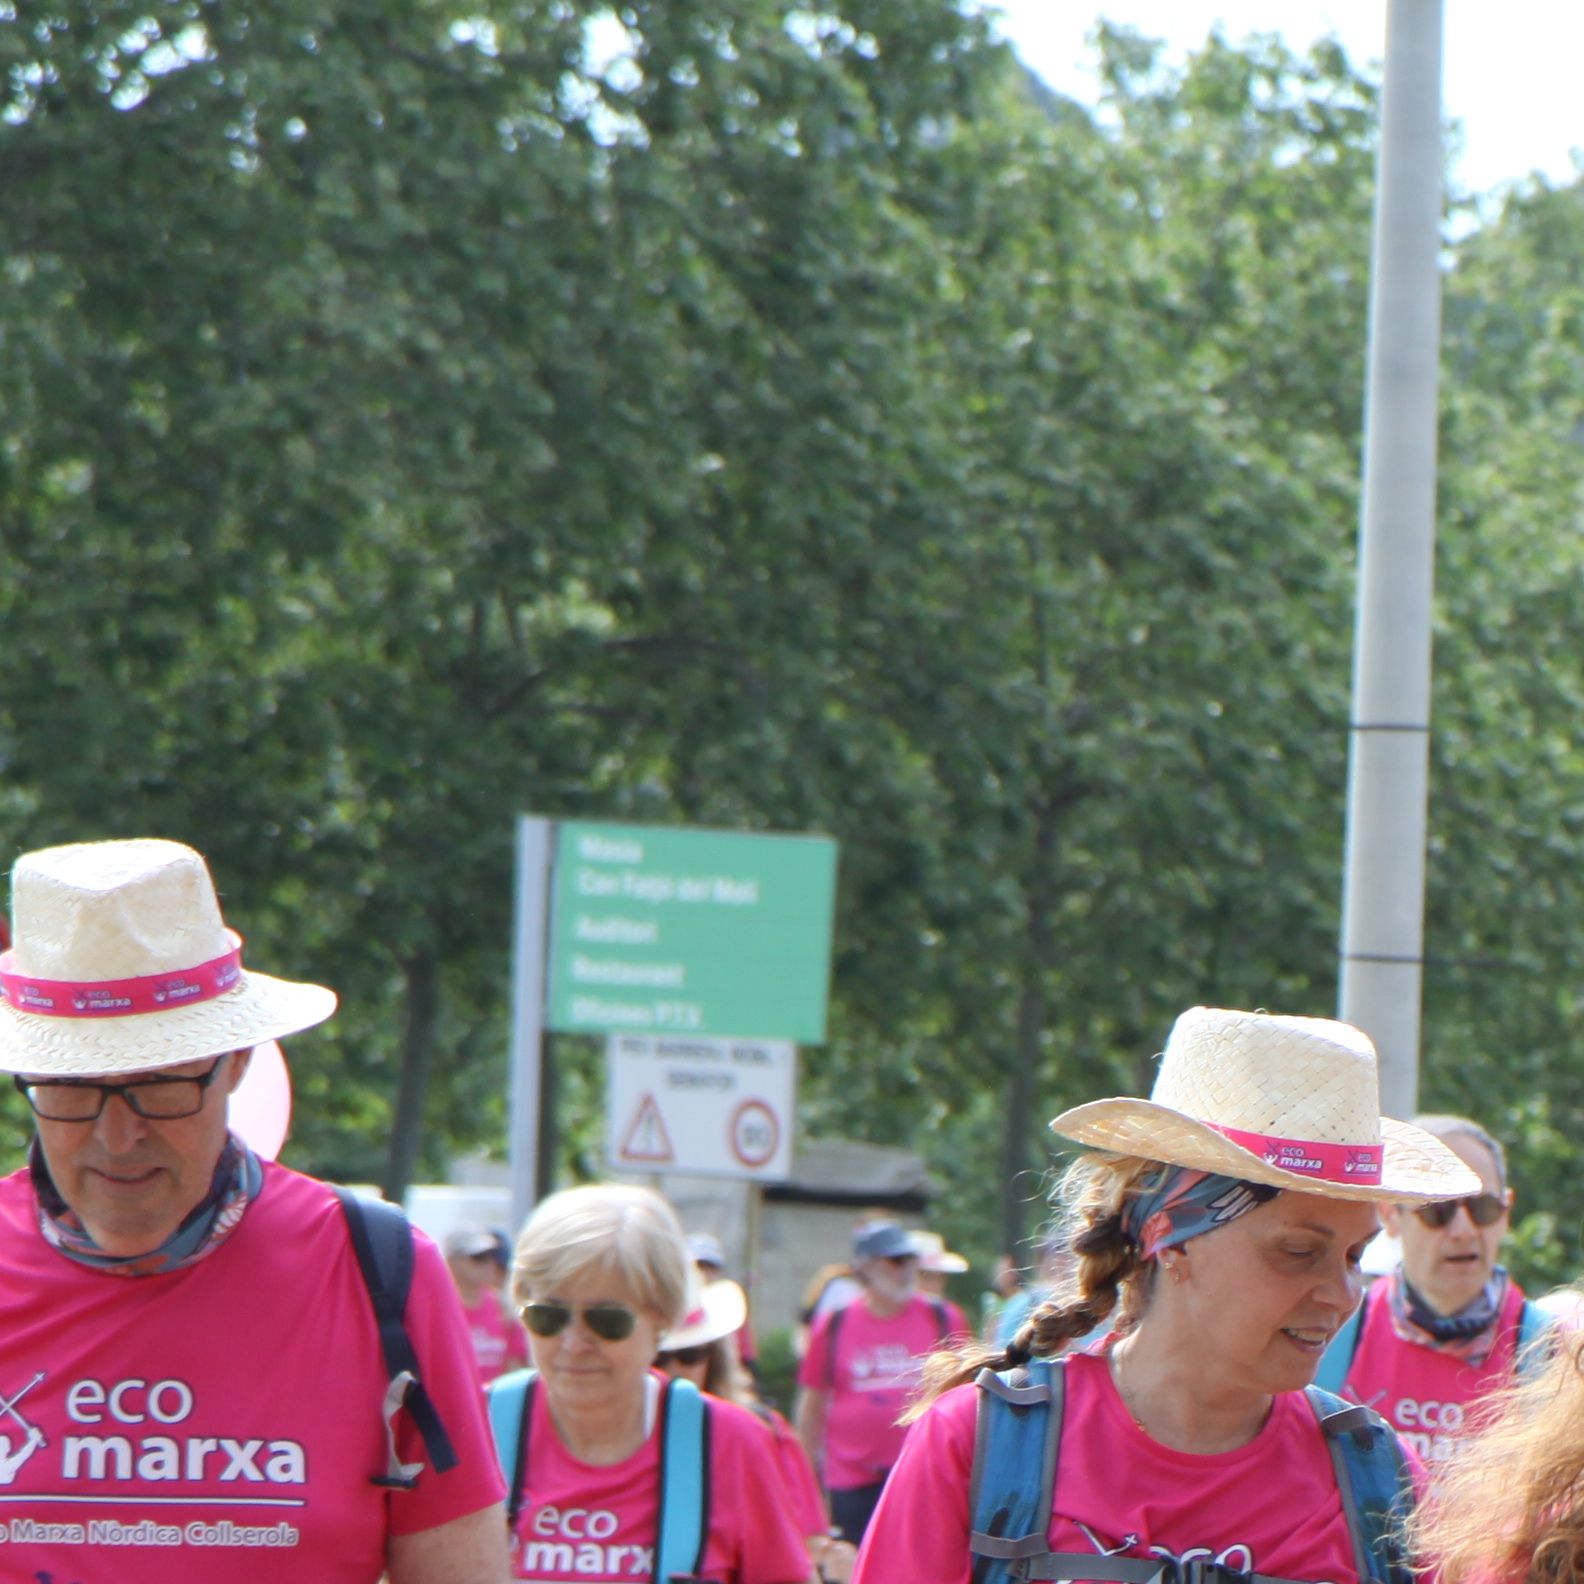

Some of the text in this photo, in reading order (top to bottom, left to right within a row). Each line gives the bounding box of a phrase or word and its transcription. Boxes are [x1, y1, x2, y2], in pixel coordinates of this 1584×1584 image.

[1280, 1156, 1323, 1170] marxa
[66, 1378, 193, 1424] eco
[1394, 1398, 1466, 1431] eco
[62, 1435, 306, 1485] marxa
[10, 1519, 300, 1547] Marxa Nòrdica Collserola
[533, 1505, 619, 1539] eco
[523, 1541, 655, 1575] marx
